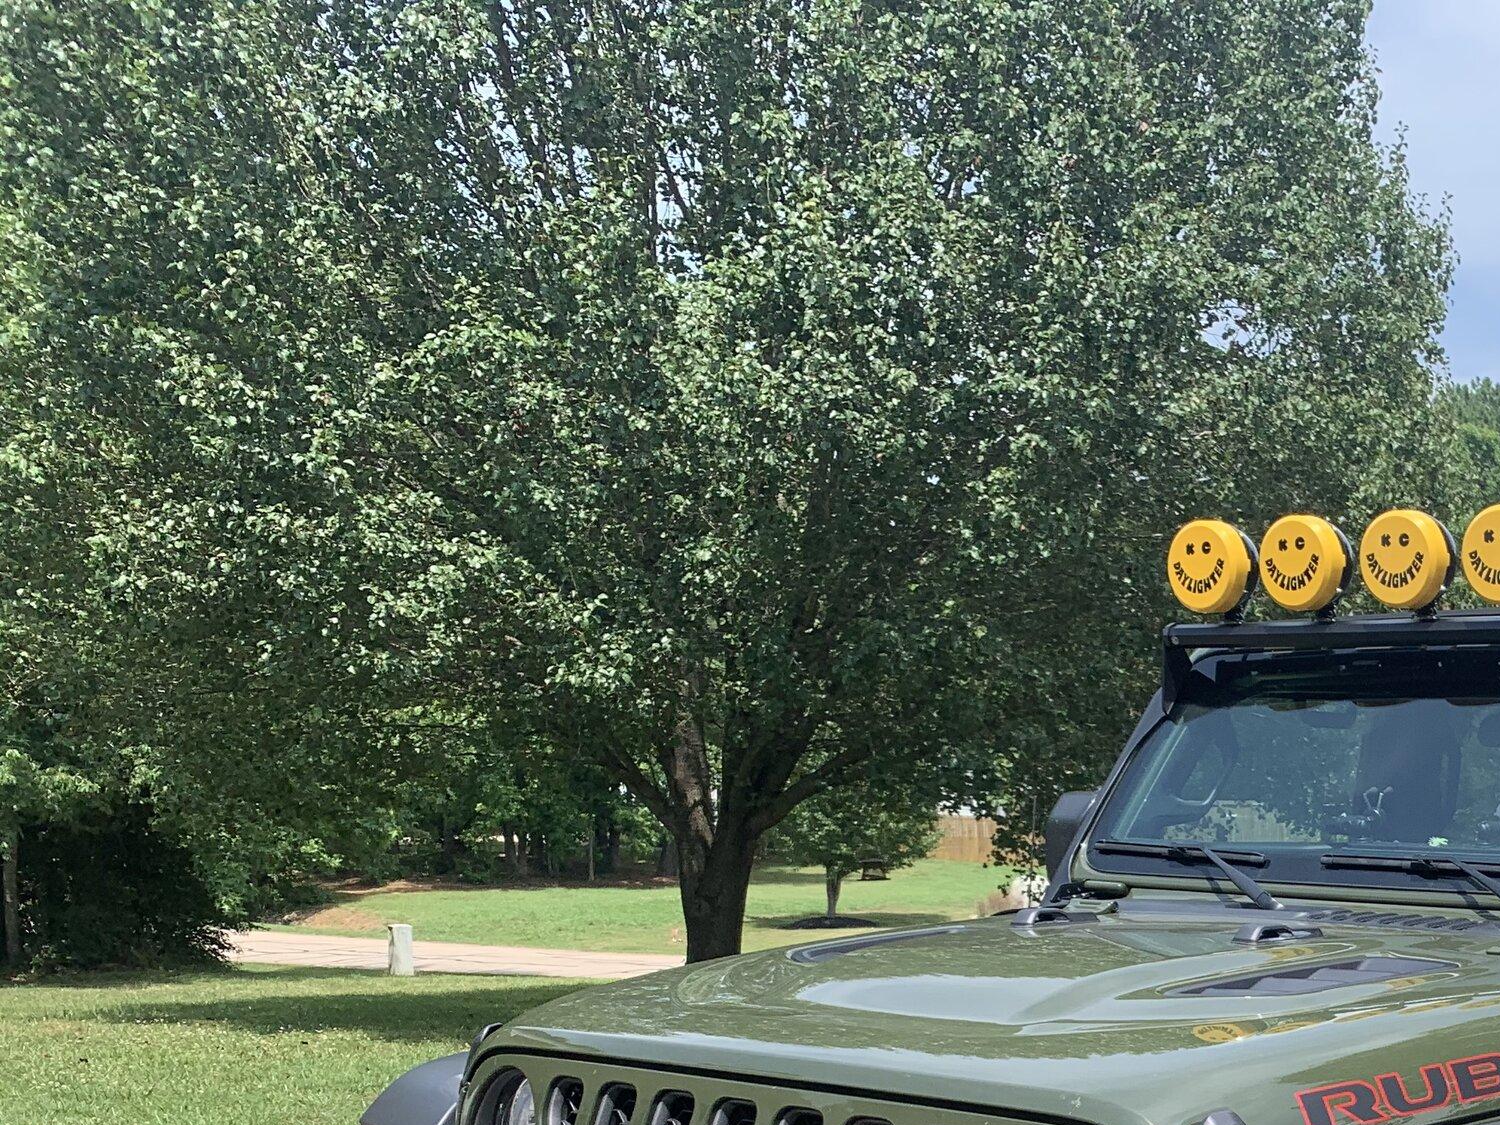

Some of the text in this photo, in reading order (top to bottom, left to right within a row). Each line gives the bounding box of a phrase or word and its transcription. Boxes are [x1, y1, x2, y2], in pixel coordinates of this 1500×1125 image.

[1173, 558, 1225, 594] DAYLIGHTER
[1264, 553, 1320, 591] DAYLIGHTER
[1366, 551, 1424, 588] DAYLIGHTER
